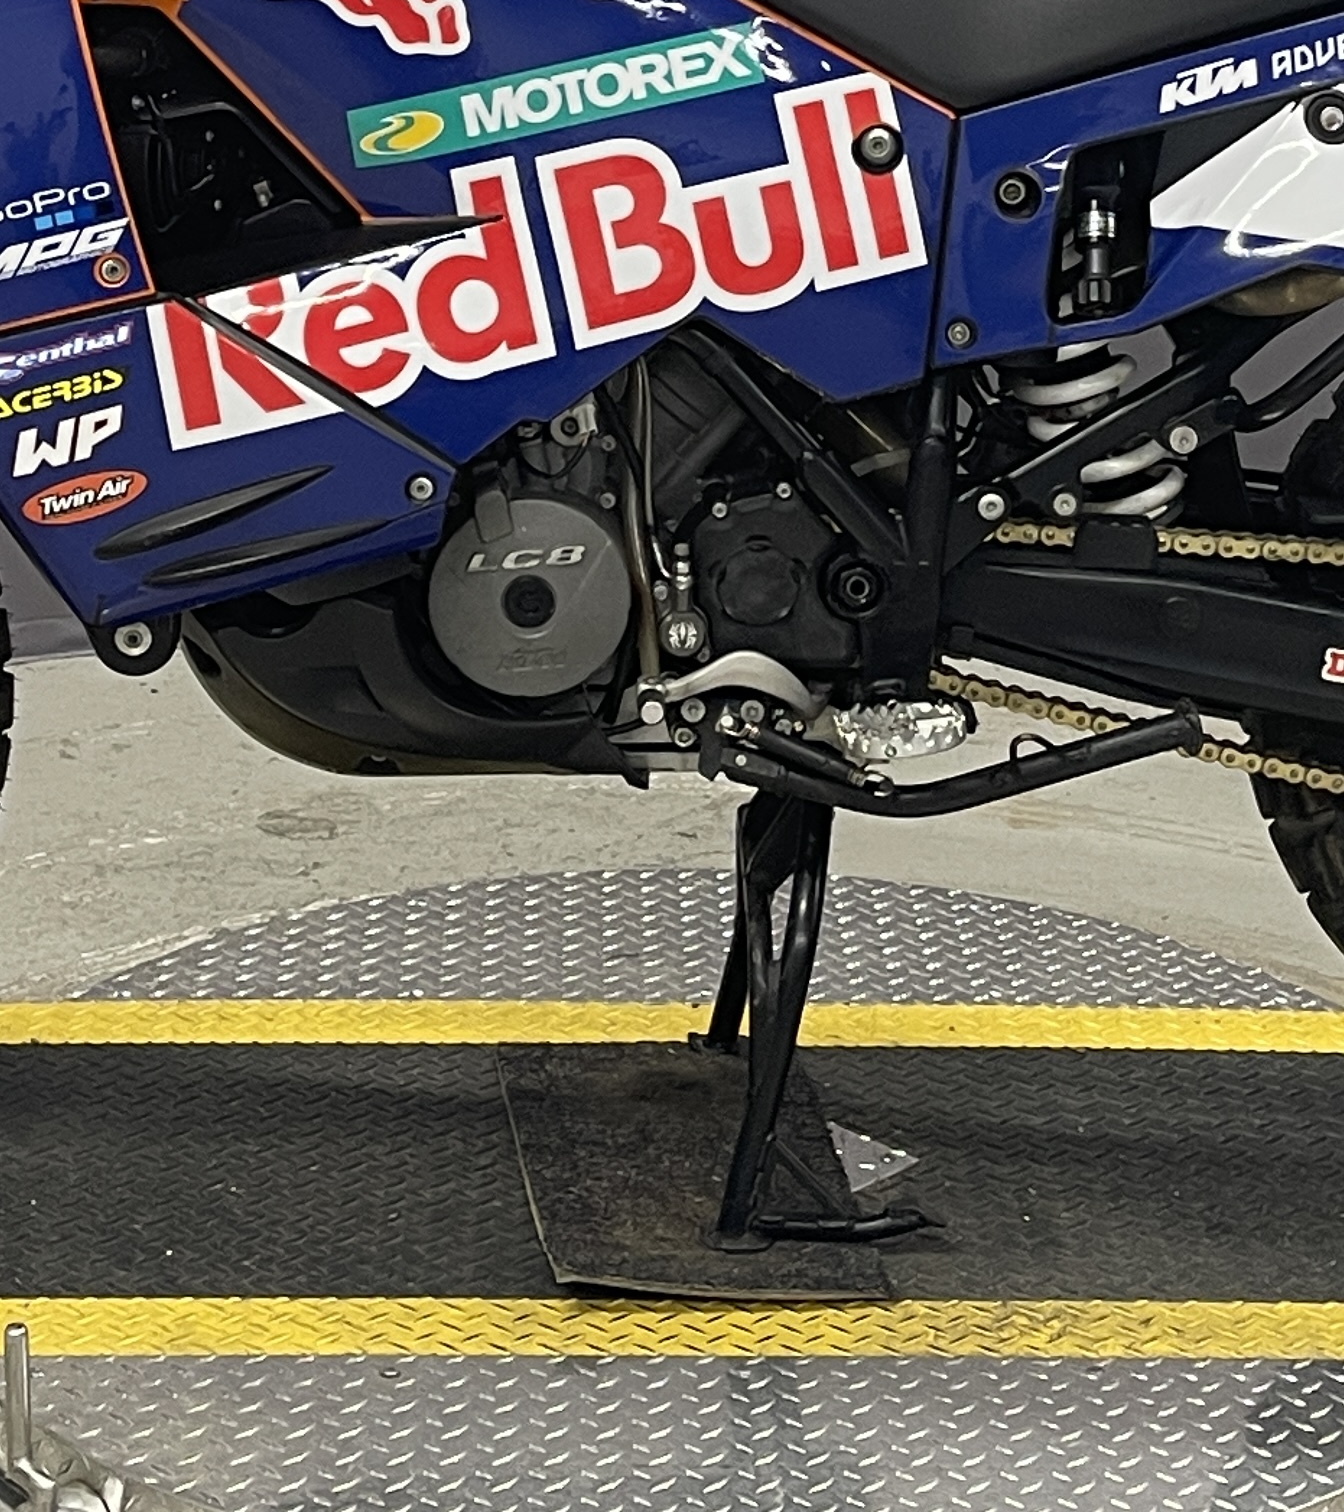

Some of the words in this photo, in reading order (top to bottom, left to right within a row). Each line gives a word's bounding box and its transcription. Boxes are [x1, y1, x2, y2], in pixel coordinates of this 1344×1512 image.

[460, 38, 751, 137] MOTOREX
[1160, 57, 1258, 113] KTM
[162, 176, 538, 431] Red
[555, 86, 909, 333] Bull
[12, 404, 123, 477] WP
[40, 489, 94, 516] Twin
[97, 477, 132, 500] Air
[467, 545, 586, 572] LC8
